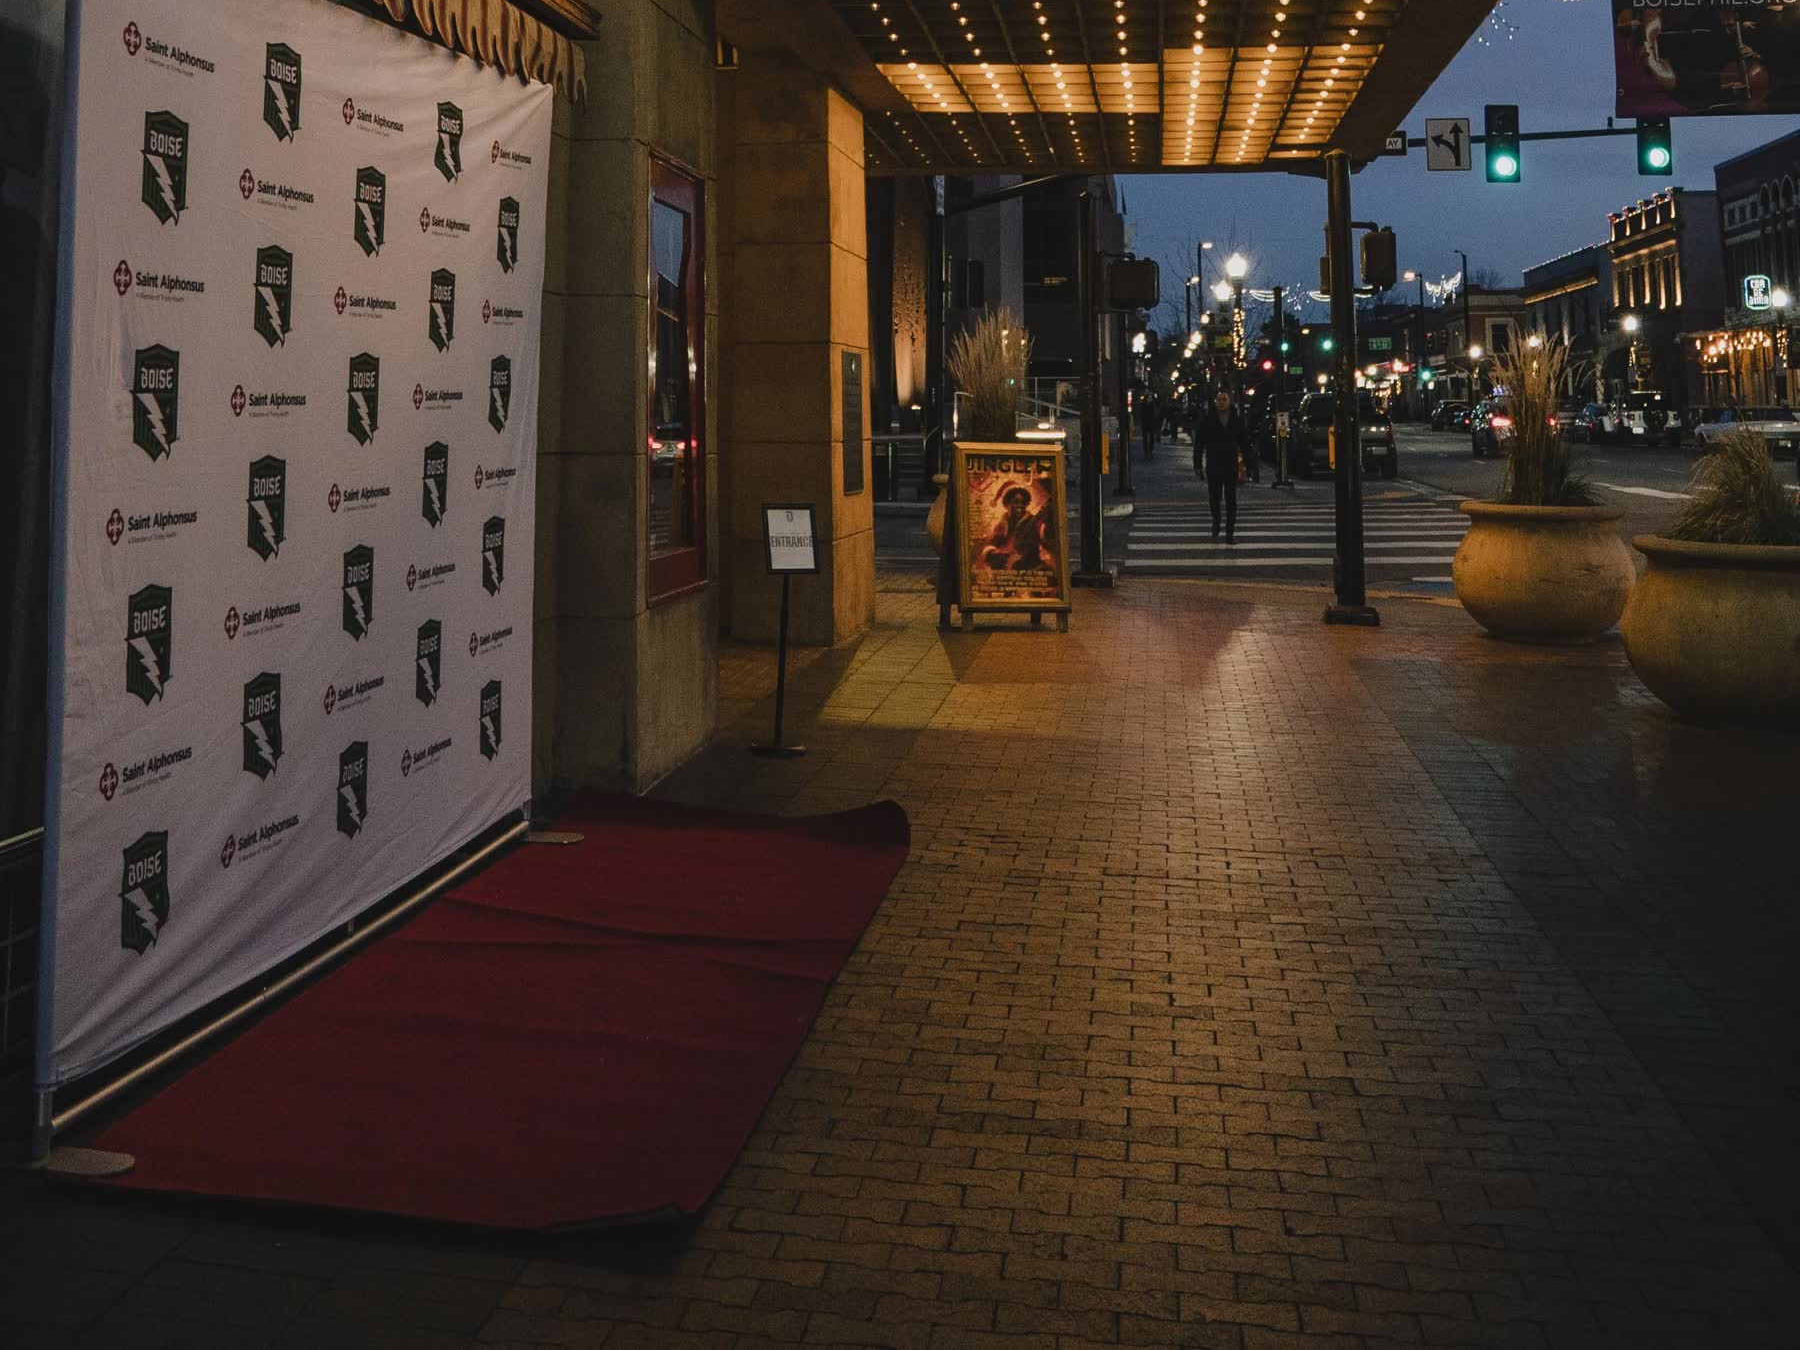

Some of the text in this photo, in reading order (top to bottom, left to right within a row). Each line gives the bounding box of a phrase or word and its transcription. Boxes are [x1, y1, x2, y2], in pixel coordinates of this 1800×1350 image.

[145, 37, 169, 57] Saint
[170, 47, 215, 73] Alphonsus
[270, 58, 297, 84] BOISE
[357, 109, 372, 123] Saint
[150, 130, 183, 157] BOISE
[257, 180, 276, 196] Saint
[360, 182, 382, 202] BOISE
[136, 272, 205, 293] Saint Alphonsus
[260, 264, 288, 285] BOISE
[140, 367, 174, 389] BOISE
[353, 371, 376, 388] BOISE
[249, 393, 268, 406] Saint
[254, 476, 281, 496] BOISE
[128, 511, 197, 531] Saint Alphonsus
[133, 606, 167, 634] BOISE
[243, 610, 262, 626] Saint
[248, 690, 276, 717] BOISE
[123, 747, 192, 783] Saint Alphonsus
[238, 831, 257, 850] Saint
[128, 850, 162, 886] BOISE
